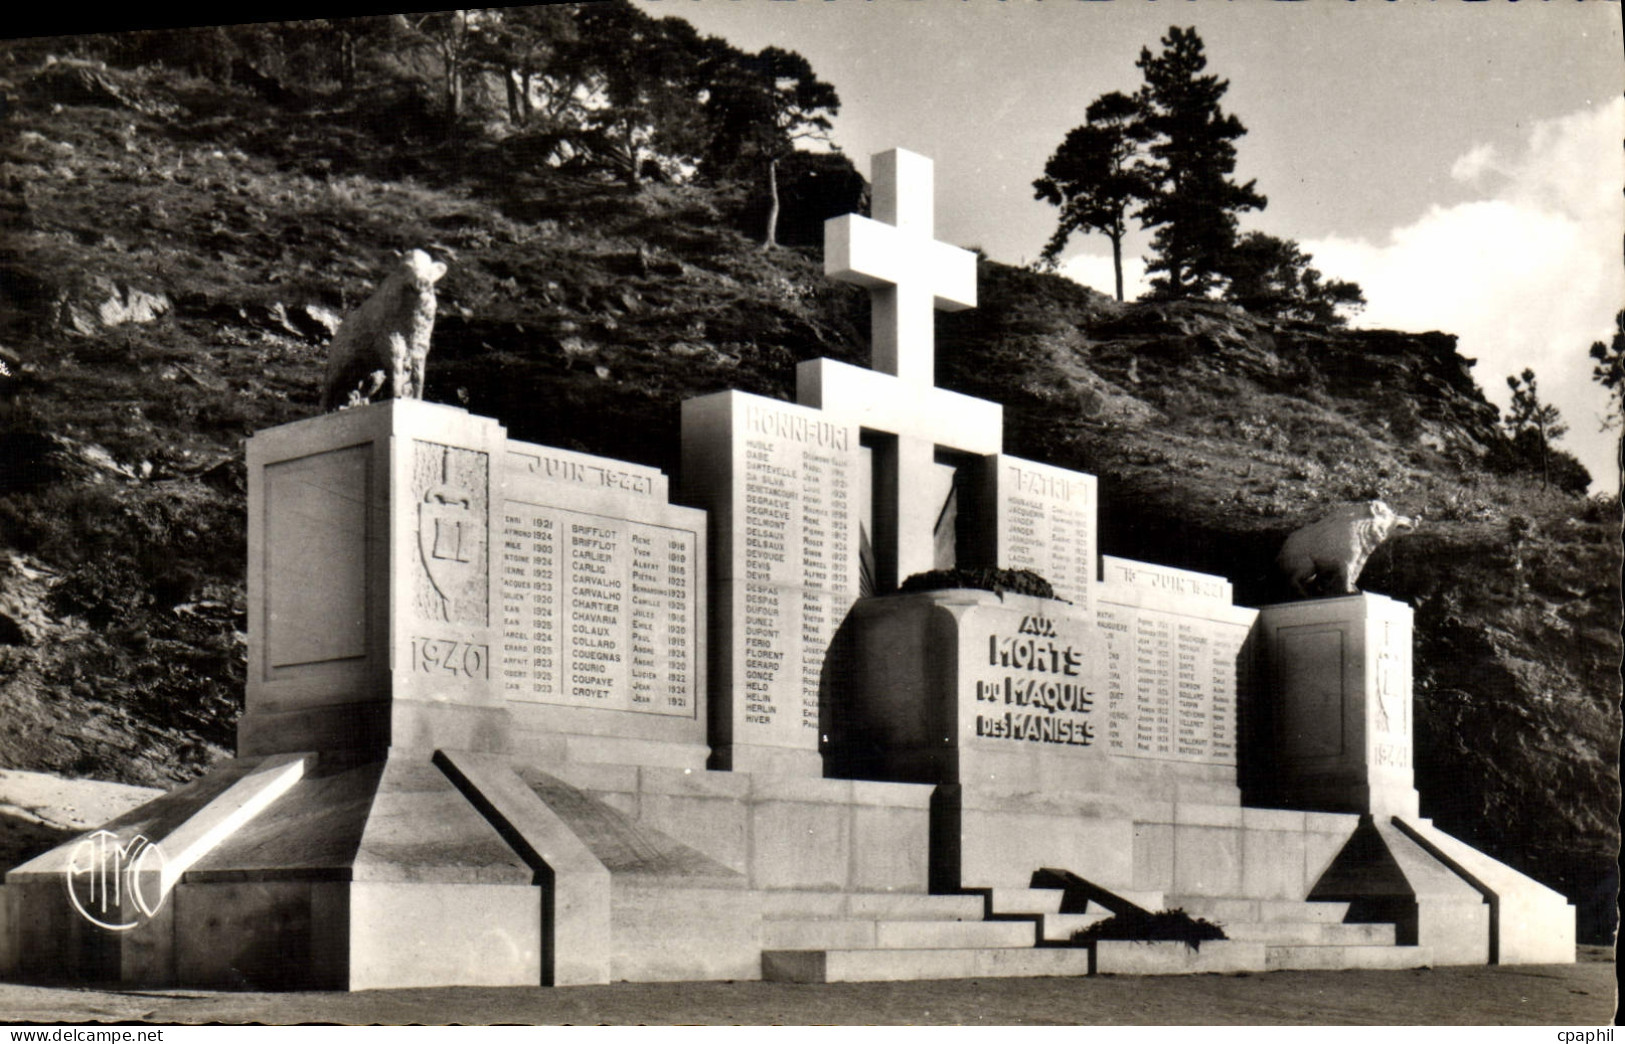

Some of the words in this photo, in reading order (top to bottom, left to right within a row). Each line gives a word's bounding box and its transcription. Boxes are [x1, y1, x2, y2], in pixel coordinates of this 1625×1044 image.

[528, 455, 585, 482] JUIN
[746, 494, 790, 510] DEGRAEVE
[746, 505, 790, 521] DEGRAEVE
[533, 518, 552, 529] 1921
[746, 516, 786, 530] DELMONT
[504, 529, 532, 538] AYMOND
[533, 530, 552, 541] 1924
[572, 524, 617, 539] BRIFFLOT
[746, 527, 784, 540] DELSAUX
[505, 542, 522, 550] MILE
[572, 536, 616, 551] BRIFFLOT
[746, 538, 784, 551] DELSAUX
[572, 549, 612, 562] CARLIER
[746, 549, 785, 562] DEVOUGE
[504, 567, 525, 576] IERRE
[572, 562, 606, 574] CARLIG
[746, 560, 771, 572] DEVIS
[572, 574, 622, 589] CARVALHO
[746, 571, 770, 582] DEVIS
[504, 580, 531, 589] ACQUES
[572, 586, 621, 601] CARVALHO
[572, 599, 619, 612] CHARTIER
[746, 594, 778, 606] DESPAS
[504, 605, 520, 613] EAN
[746, 604, 779, 616] DUFOUR
[504, 618, 520, 626] EAN
[572, 612, 617, 625] CHAVARIA
[746, 616, 774, 628] DUNEZ
[572, 624, 610, 636] COLAUX
[746, 626, 780, 639] DUPONT
[1018, 615, 1058, 638] AUX
[503, 632, 528, 640] ARCEL
[533, 632, 552, 642] 1924
[572, 636, 616, 649] COLLARD
[504, 644, 528, 652] ERARD
[746, 648, 784, 660] FLORENT
[572, 649, 621, 662] COUEGNAS
[989, 634, 1084, 676] MORTS
[572, 662, 606, 674] COURIO
[746, 660, 780, 671] GERARD
[572, 674, 614, 687] COUPAYE
[746, 670, 774, 682] GONCE
[572, 687, 610, 698] CROYET
[746, 682, 768, 692] HELD
[746, 693, 771, 702] HELIN
[977, 680, 1000, 702] DU
[1004, 677, 1096, 714] MAQUIS
[746, 704, 776, 714] HERLIN
[746, 715, 771, 724] HIVER
[977, 715, 1006, 739] DES
[1005, 712, 1096, 746] MANISES
